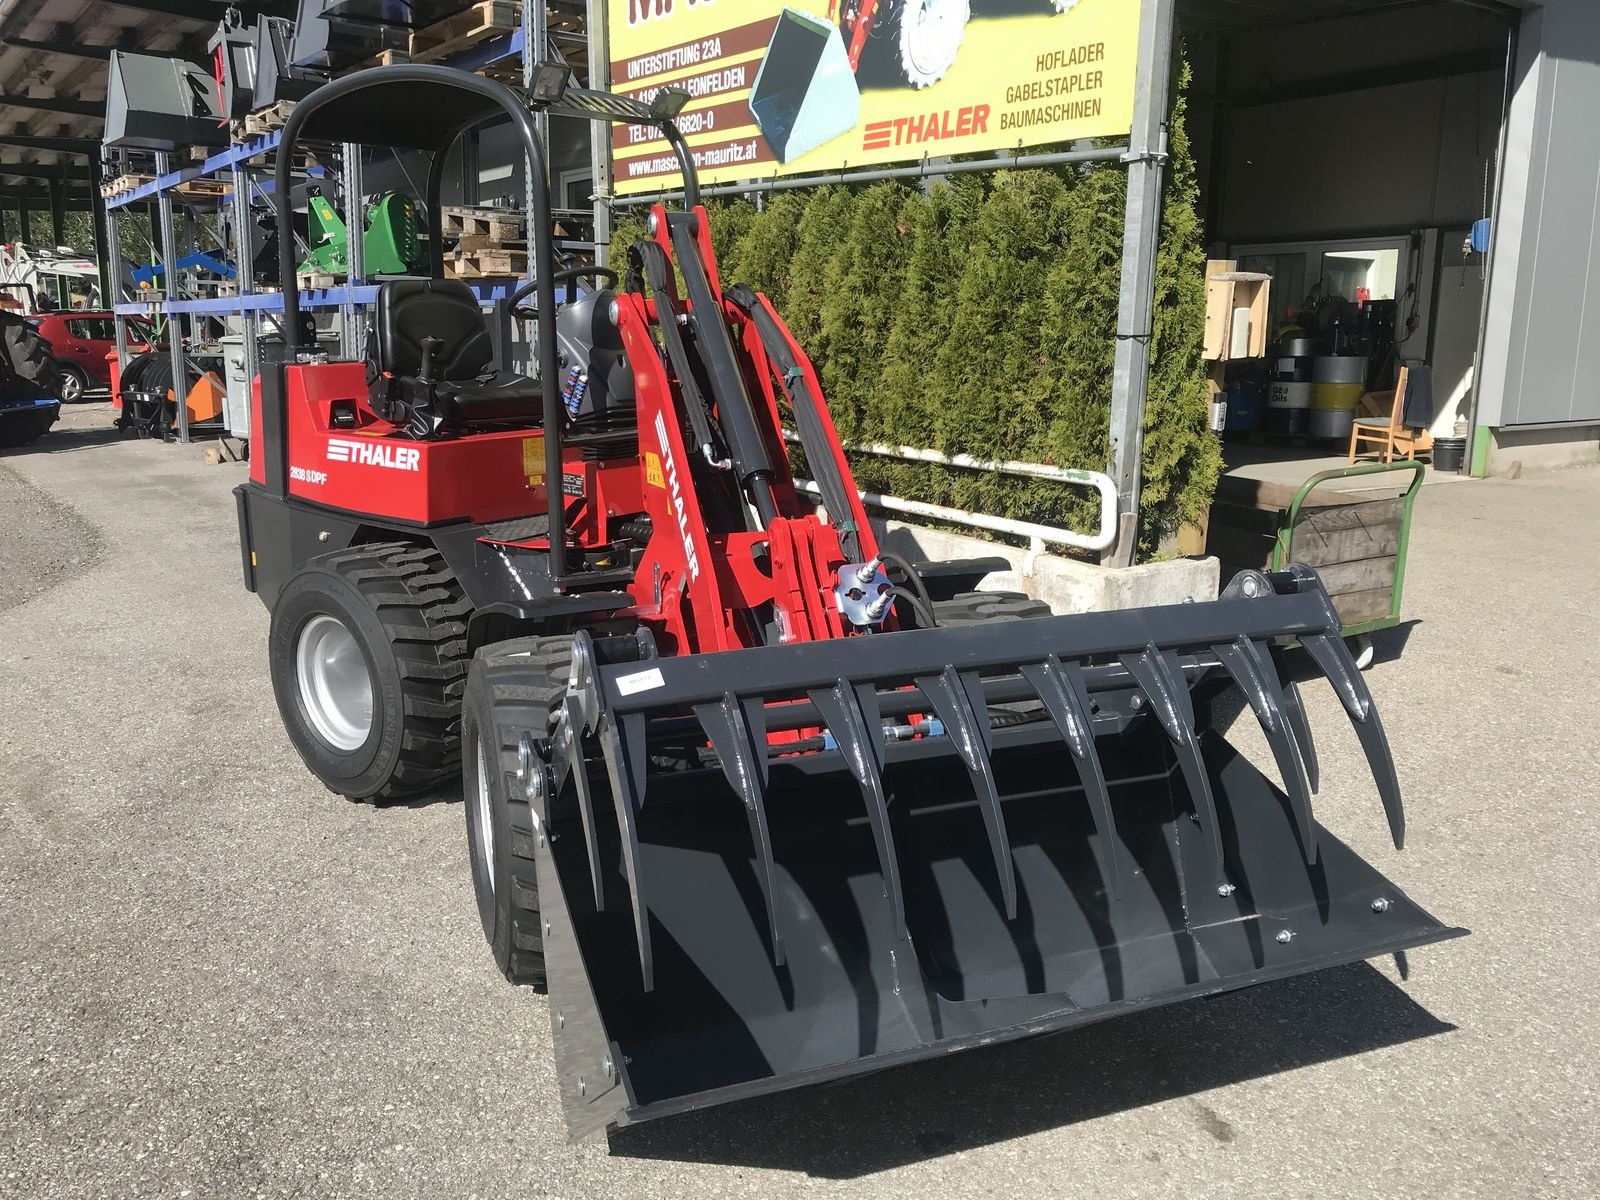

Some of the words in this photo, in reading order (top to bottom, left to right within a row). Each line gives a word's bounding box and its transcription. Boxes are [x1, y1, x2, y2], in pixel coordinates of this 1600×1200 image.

[628, 44, 700, 79] UNTERSTIFTUNG
[702, 38, 721, 60] 23A
[1036, 42, 1104, 72] HOFLADER
[1006, 70, 1103, 104] GABELSTAPLER
[628, 124, 647, 143] TEL:
[648, 111, 714, 140] 07/6820-0
[892, 104, 991, 146] THALER
[1000, 98, 1102, 130] BAUMASCHINEN
[629, 140, 757, 176] www.mascn-mauritz.at
[348, 441, 420, 471] THALER
[666, 447, 699, 583] THALER
